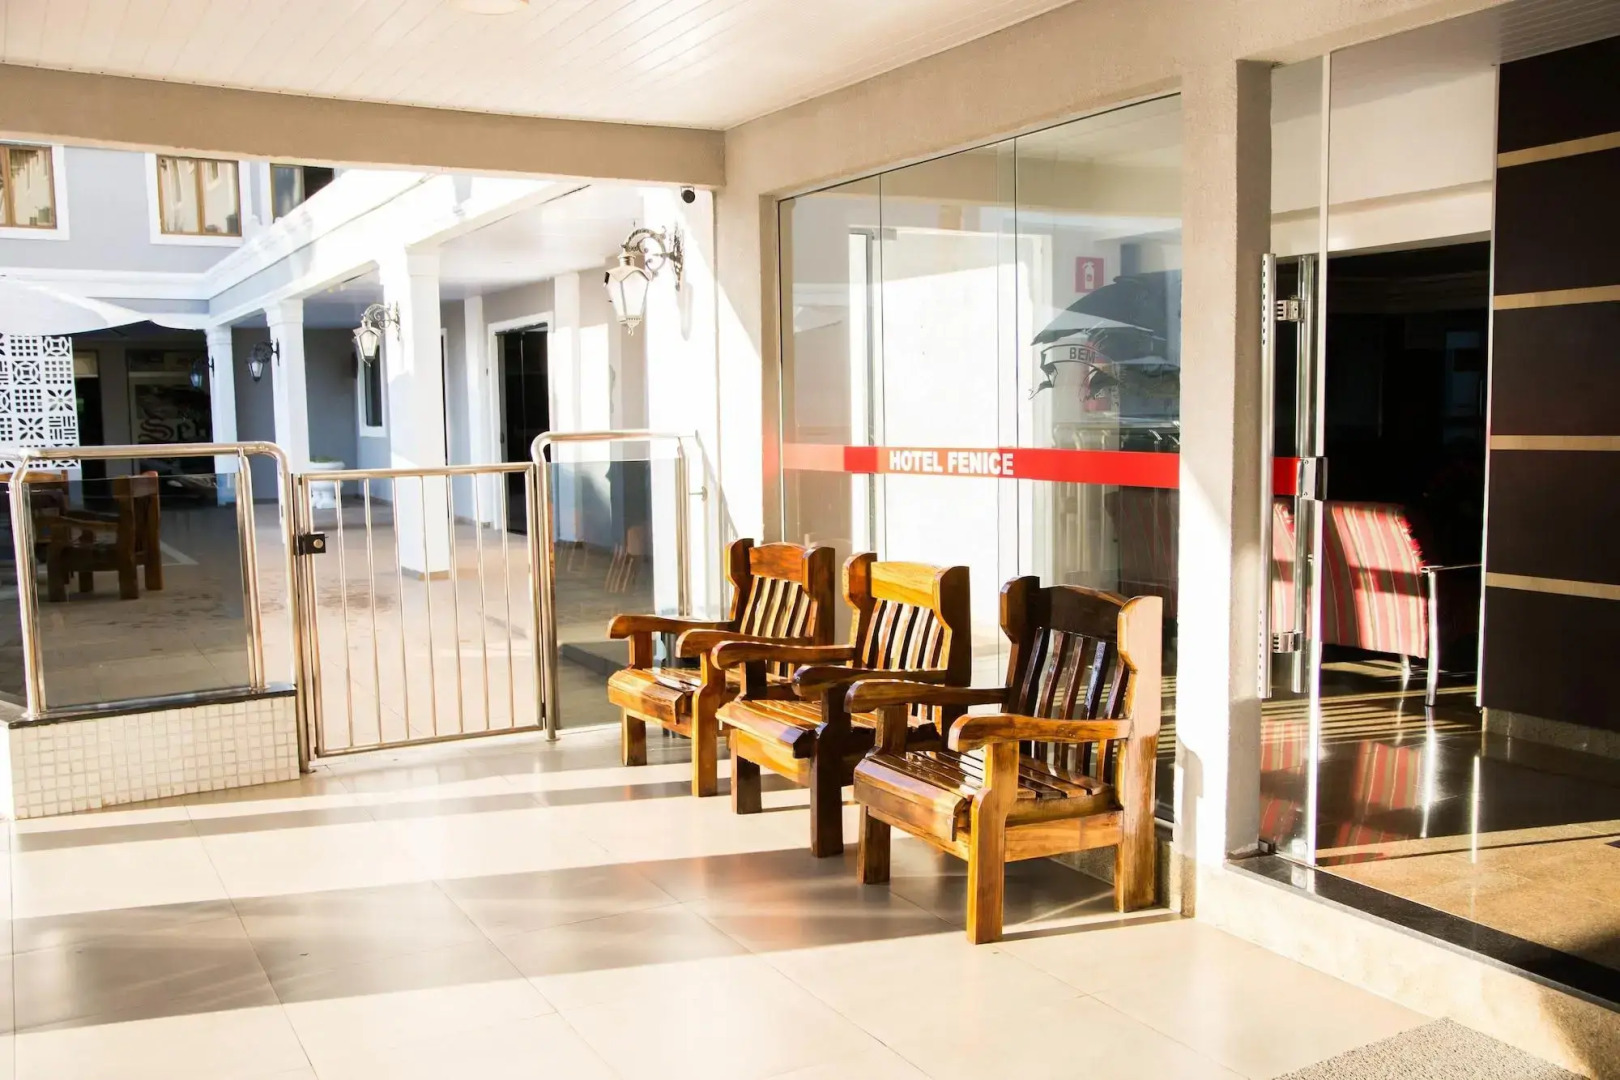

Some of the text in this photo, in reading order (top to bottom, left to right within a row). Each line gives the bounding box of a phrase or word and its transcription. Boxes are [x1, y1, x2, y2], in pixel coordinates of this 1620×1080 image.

[1069, 347, 1096, 364] BEM
[889, 450, 1014, 475] HOTEL FENICE
